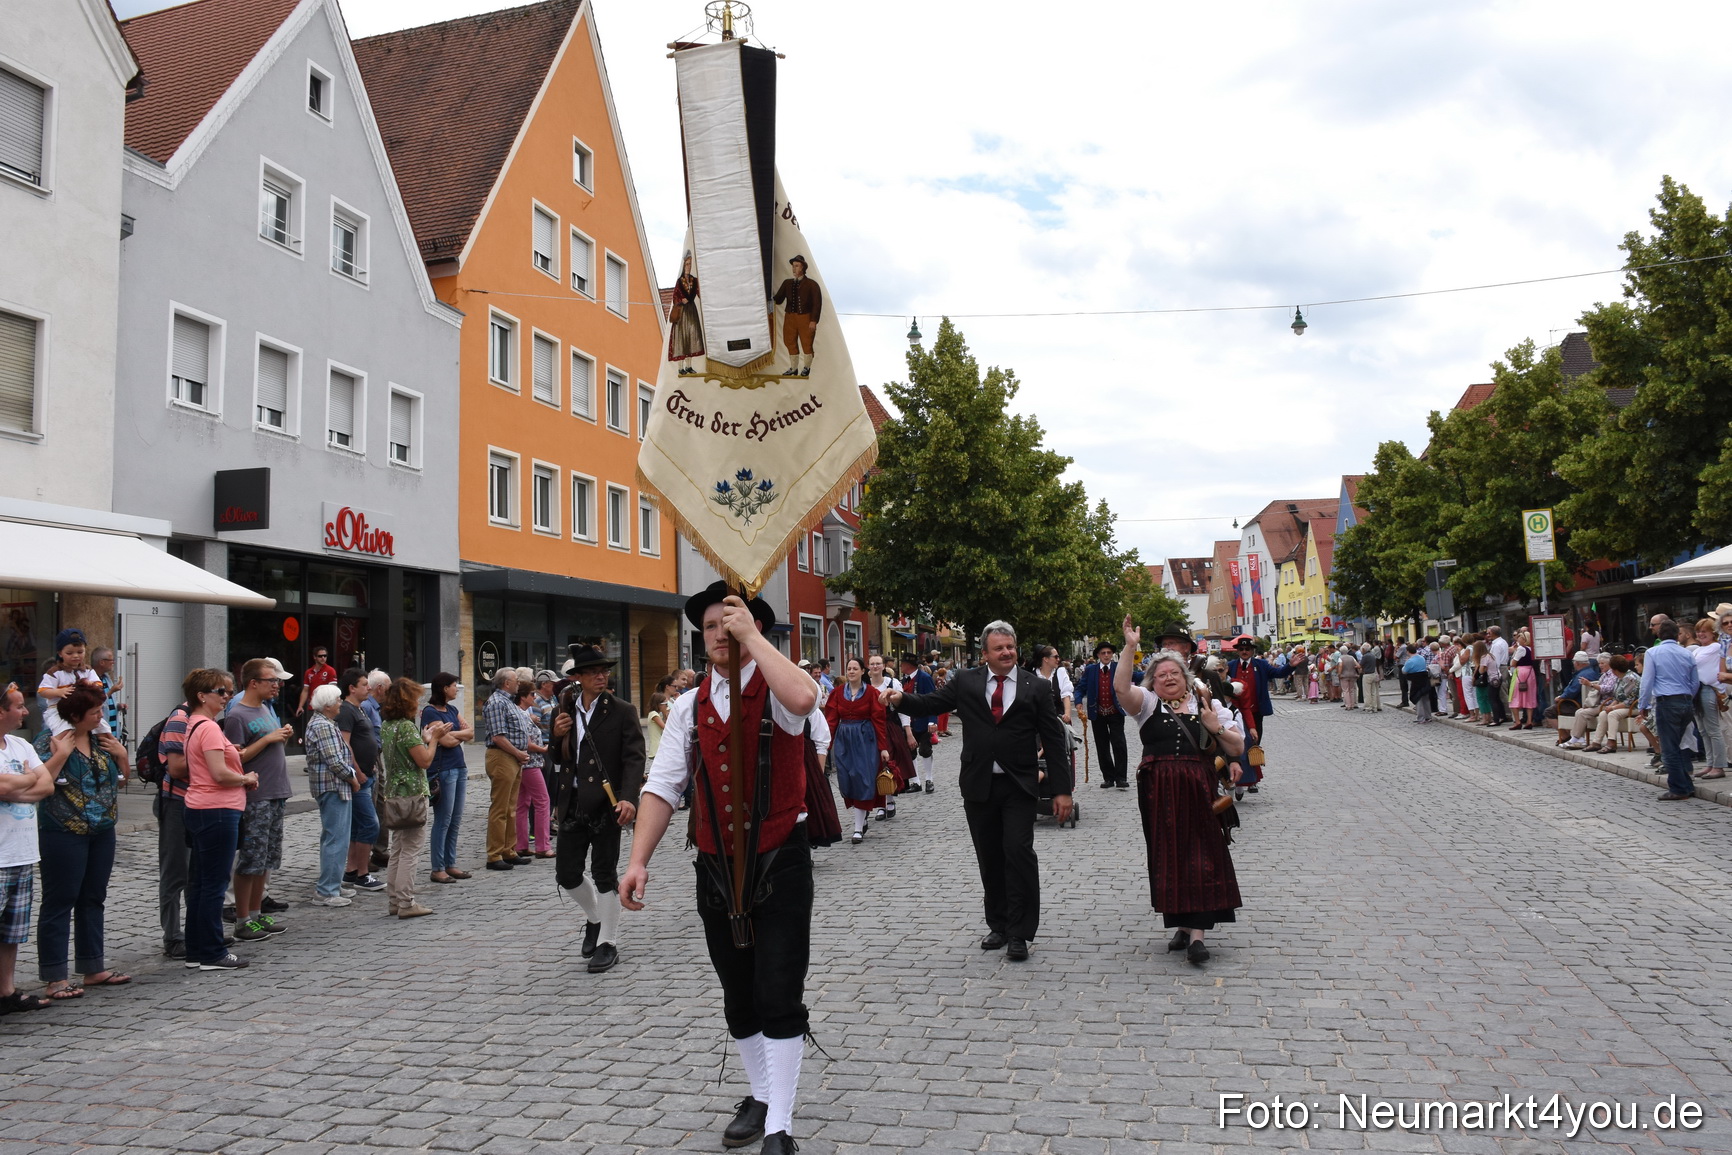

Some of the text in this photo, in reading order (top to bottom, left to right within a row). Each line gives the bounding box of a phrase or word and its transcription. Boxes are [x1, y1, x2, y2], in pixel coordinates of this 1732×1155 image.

[666, 389, 823, 442] Treu der Heimat
[219, 506, 259, 524] s.Oliver
[1533, 518, 1543, 529] H
[324, 506, 395, 556] s.Oliver
[151, 606, 159, 615] 29
